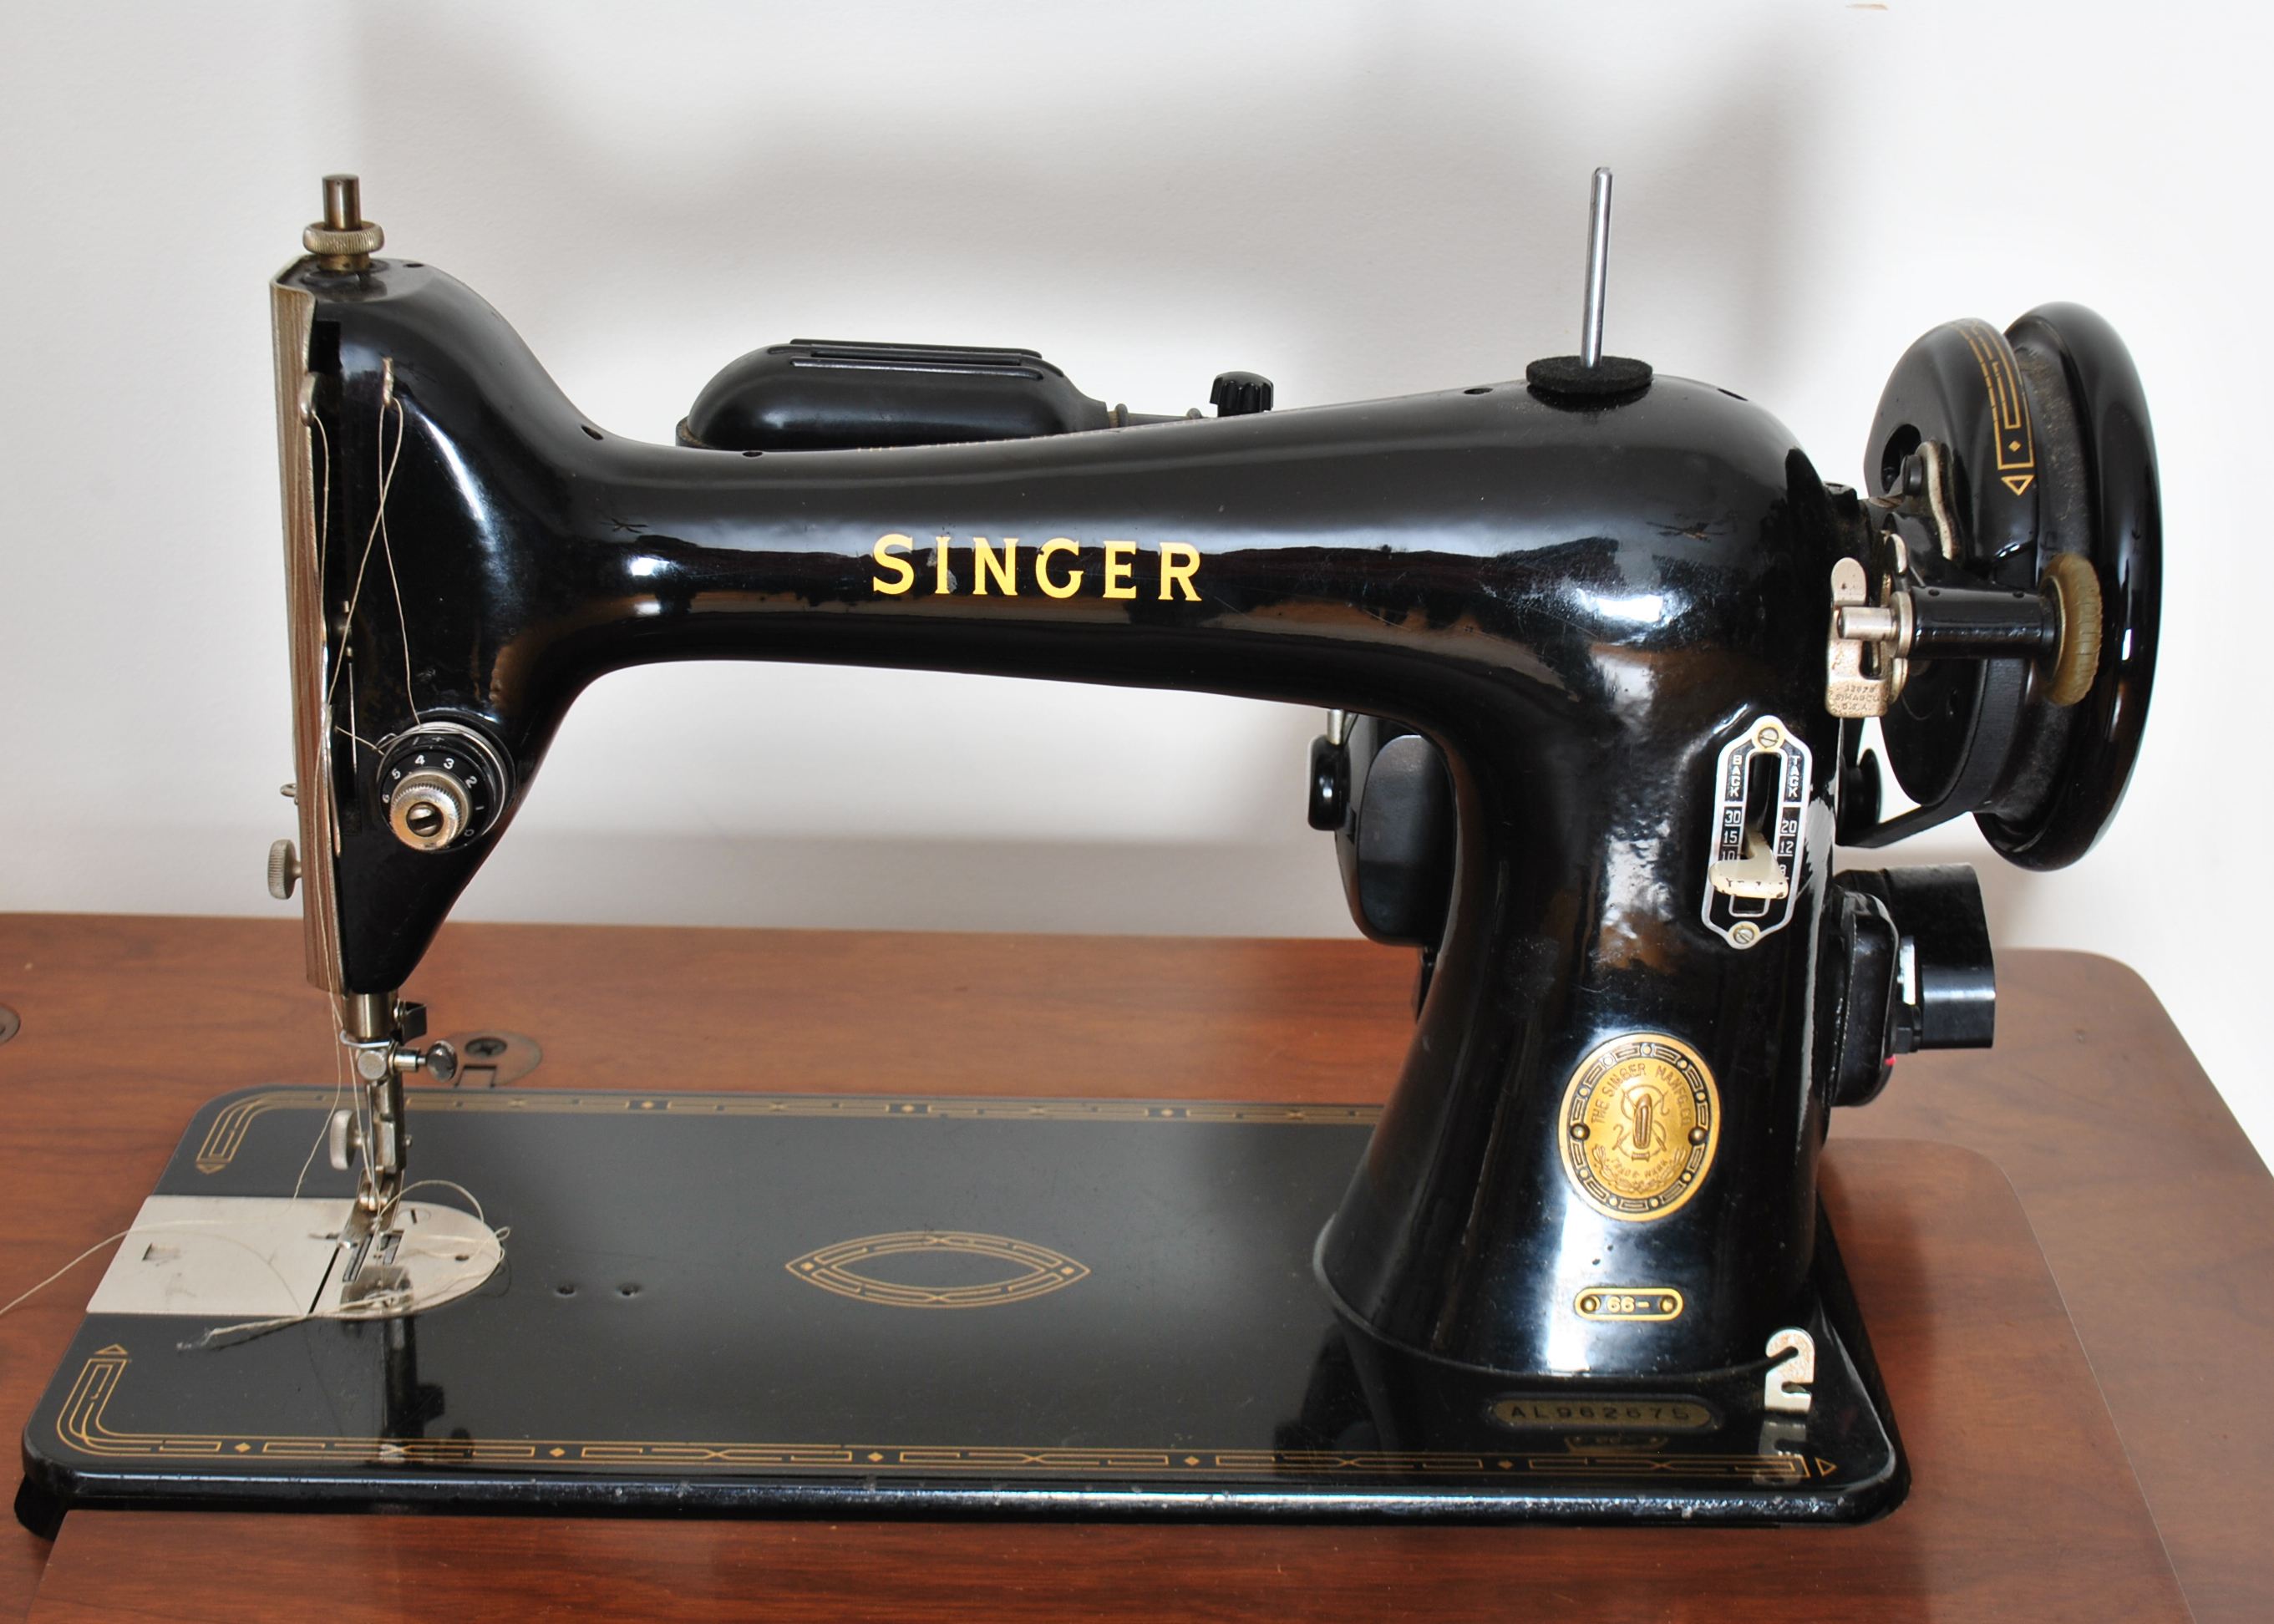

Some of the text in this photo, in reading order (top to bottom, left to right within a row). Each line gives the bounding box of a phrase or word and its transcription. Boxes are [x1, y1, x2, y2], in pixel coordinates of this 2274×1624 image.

[872, 533, 1203, 601] SINGER
[382, 794, 391, 804] 6
[391, 768, 401, 780] 5
[414, 754, 425, 766] 4
[443, 758, 455, 769] 3
[465, 775, 478, 789] 2
[1729, 754, 1743, 798] BACK
[1788, 754, 1801, 798] TACK
[1724, 809, 1741, 825] 30
[1780, 820, 1797, 835] 20
[1723, 830, 1738, 844] 15
[1779, 840, 1794, 854] 12
[1721, 850, 1735, 861] 10
[1591, 1099, 1610, 1124] THE
[1601, 1063, 1647, 1098] SINGER
